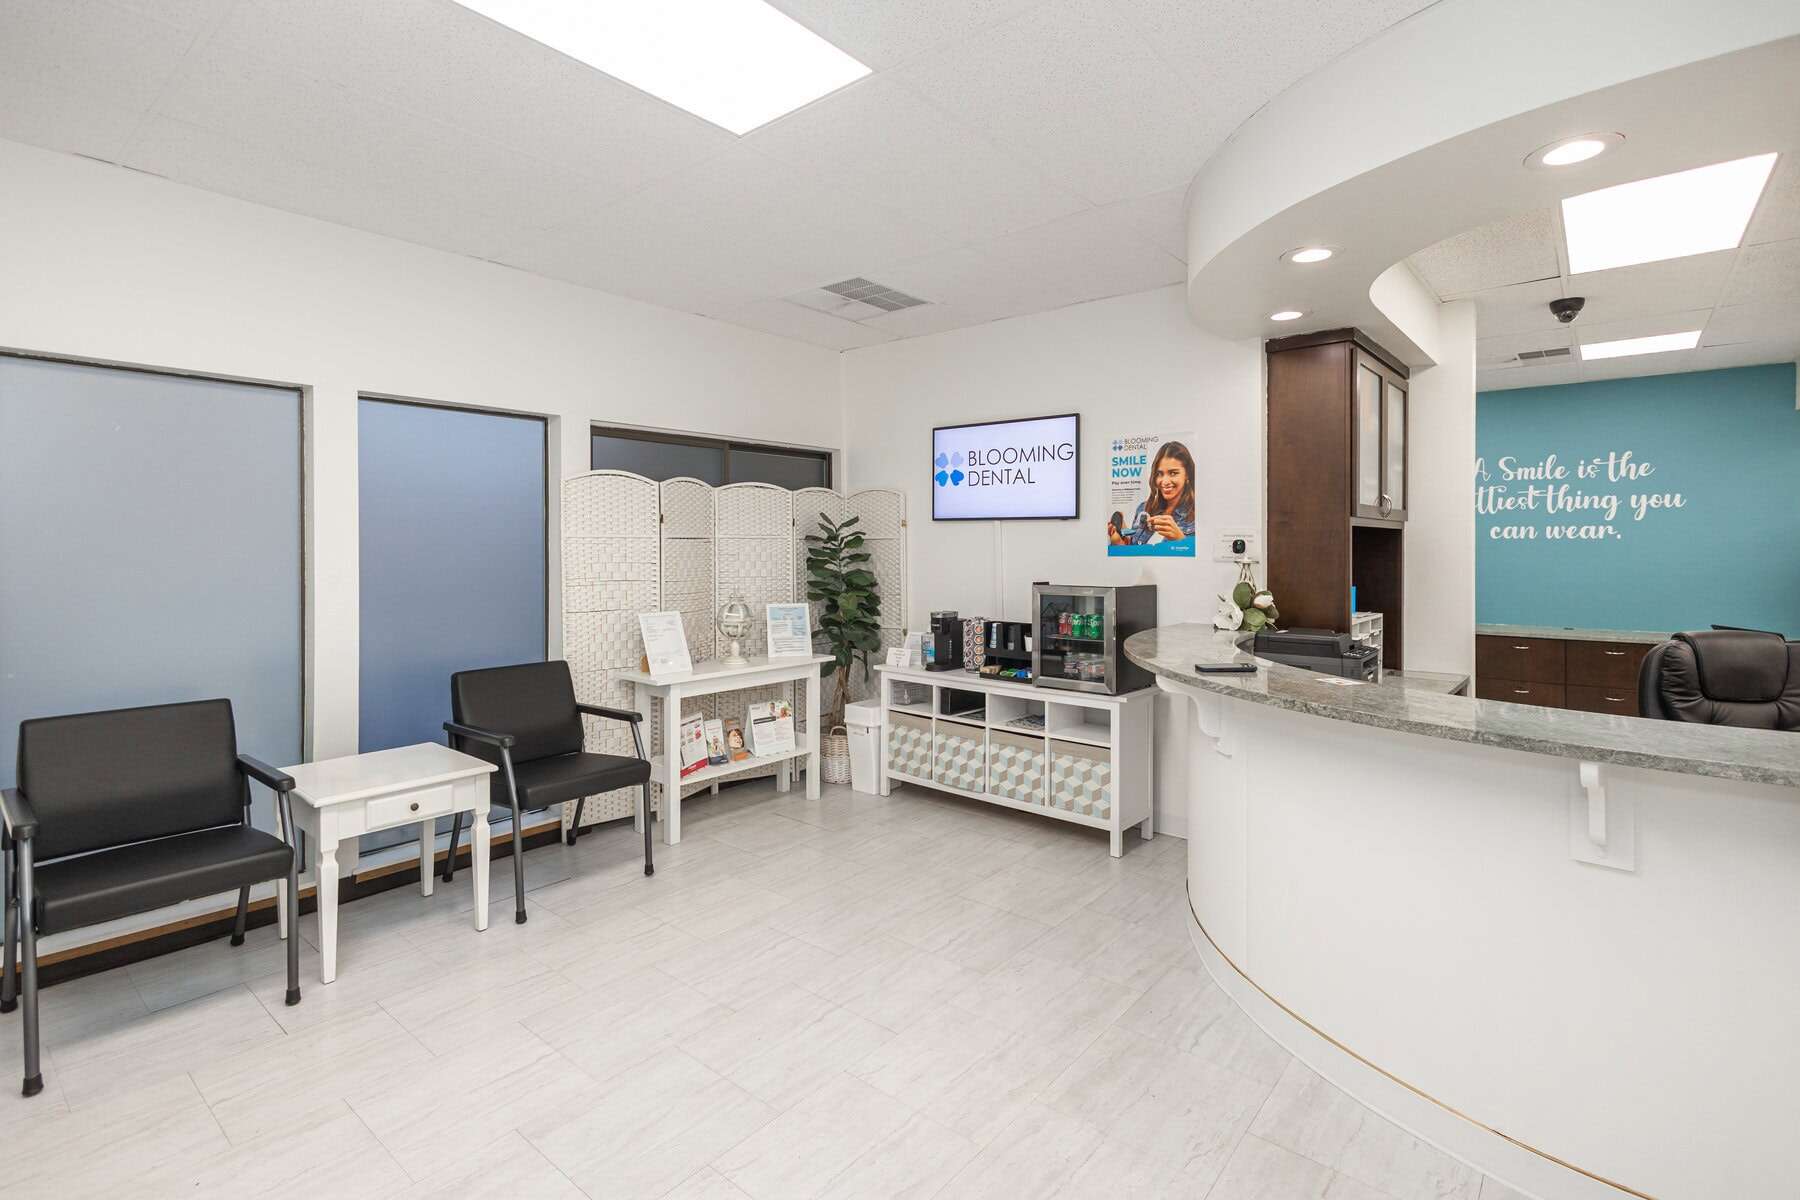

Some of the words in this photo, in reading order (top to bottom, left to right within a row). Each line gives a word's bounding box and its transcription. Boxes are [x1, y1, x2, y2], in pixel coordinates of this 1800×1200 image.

[1124, 436, 1159, 444] BLOOMING
[968, 443, 1074, 466] BLOOMING
[1111, 455, 1147, 466] SMILE
[1112, 467, 1142, 478] NOW
[1474, 457, 1491, 481] A
[1498, 454, 1570, 480] Smile
[1577, 460, 1600, 478] is
[1593, 450, 1656, 482] the
[968, 468, 1036, 487] DENTAL
[1475, 485, 1539, 514] ttiest
[1532, 484, 1622, 521] thing
[1630, 492, 1687, 521] you
[1489, 524, 1538, 540] can
[1545, 524, 1622, 540] wear.
